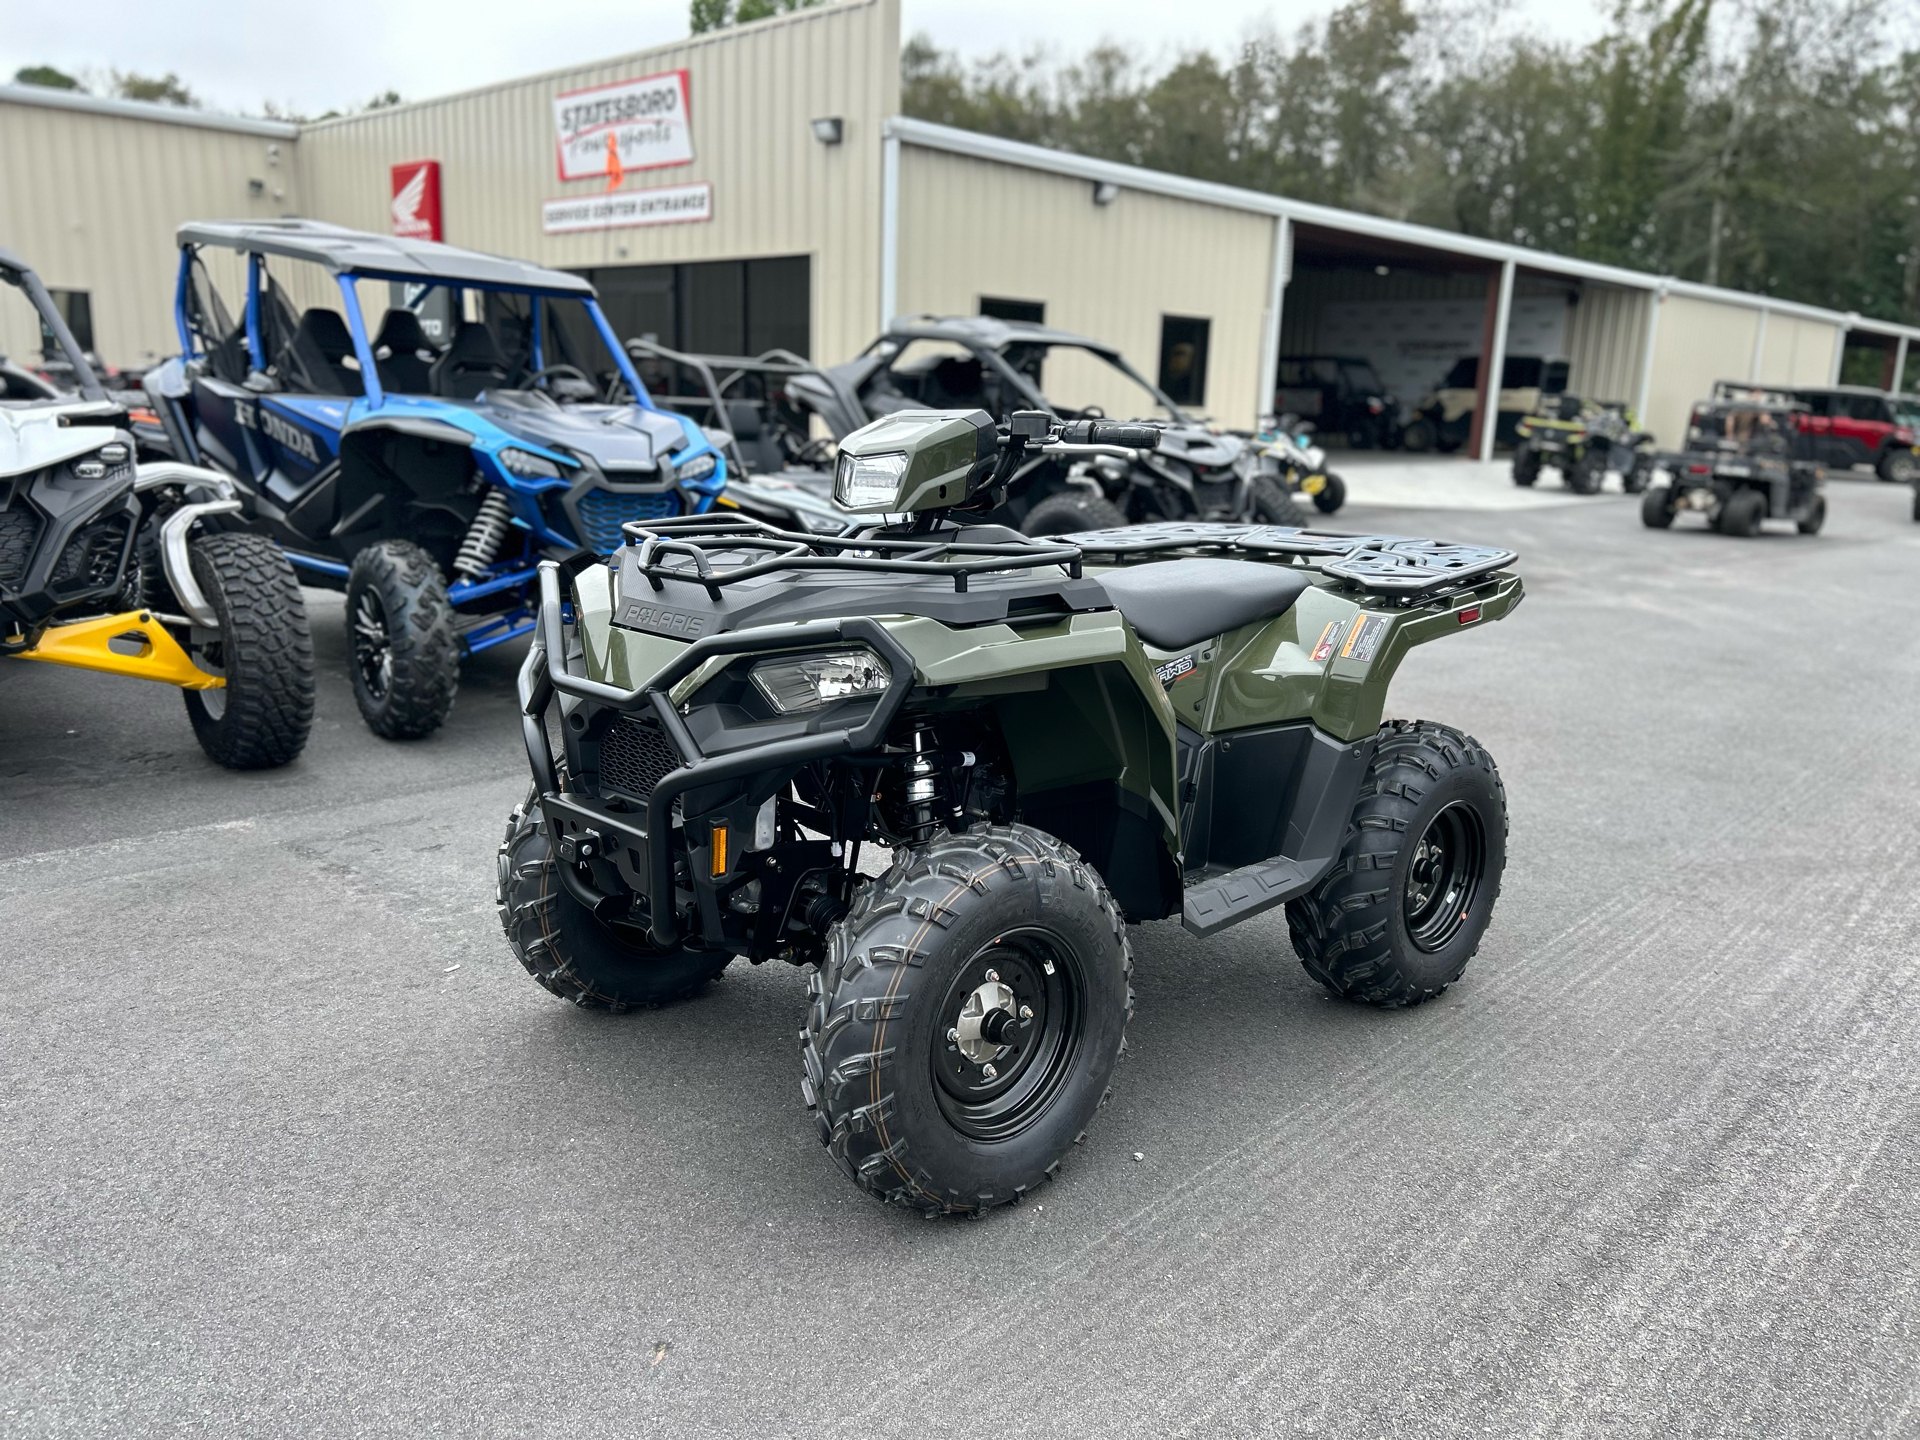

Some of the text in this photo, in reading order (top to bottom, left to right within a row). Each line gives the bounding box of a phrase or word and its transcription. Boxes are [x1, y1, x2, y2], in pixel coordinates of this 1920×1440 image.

[561, 87, 677, 134] STATESBORO
[546, 193, 705, 223] SERVICE CENTER ENTRANCE
[233, 399, 320, 464] HONDA
[624, 604, 705, 635] POLARIS
